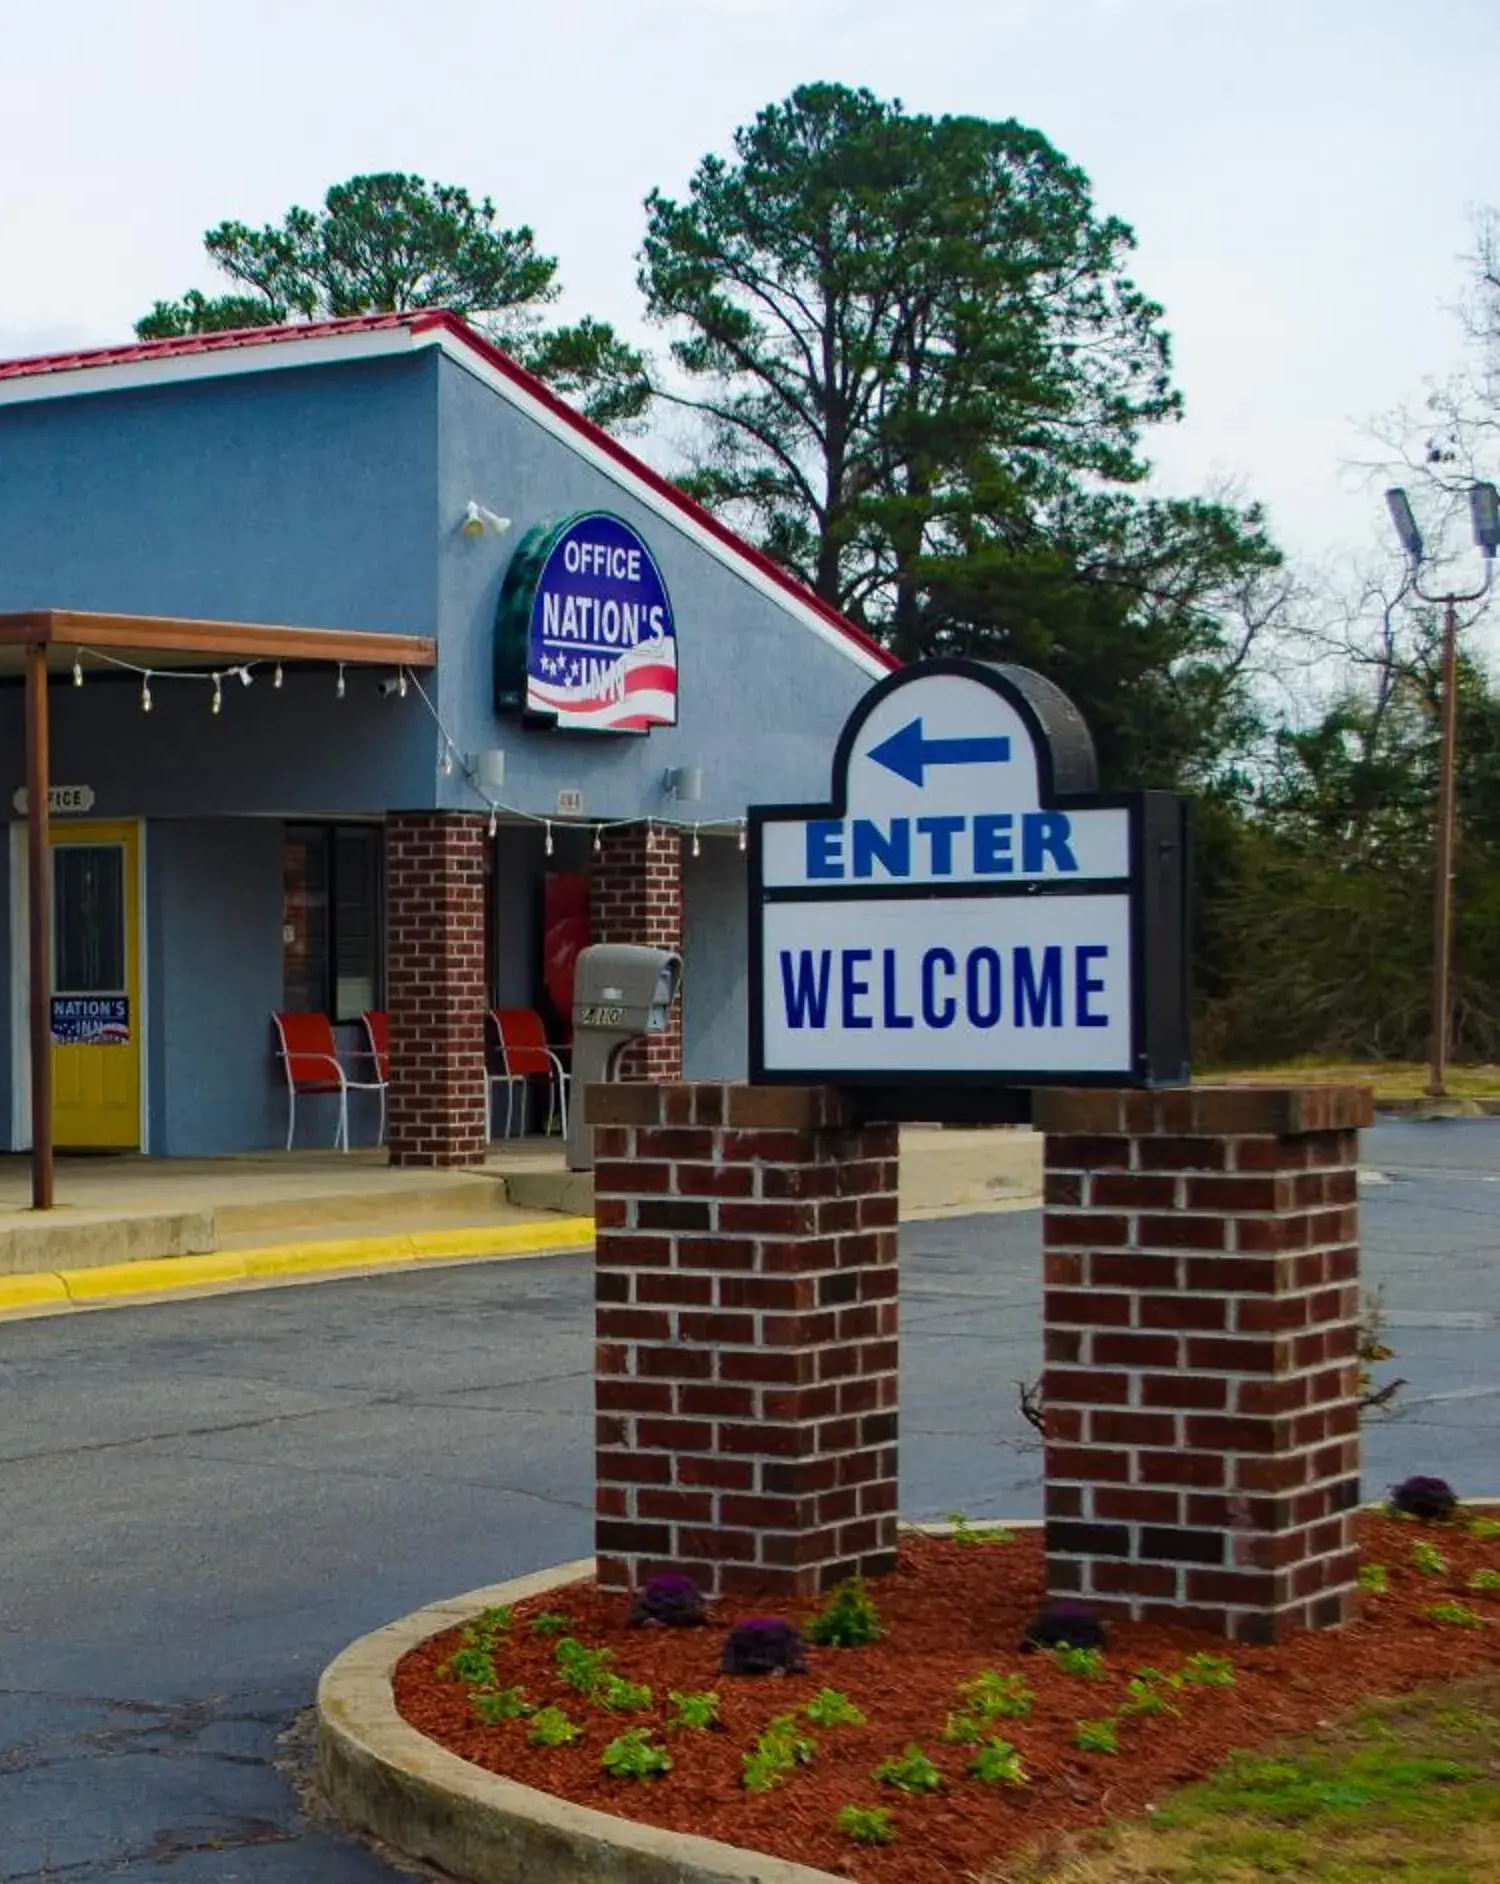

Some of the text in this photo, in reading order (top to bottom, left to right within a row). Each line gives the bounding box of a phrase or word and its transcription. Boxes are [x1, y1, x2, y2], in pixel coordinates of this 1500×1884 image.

[563, 540, 642, 582] OFFICE
[542, 591, 665, 649] NATION'S
[580, 656, 626, 701] INN
[804, 812, 1079, 879] ENTER
[53, 1000, 126, 1017] NATION'S
[779, 945, 1110, 1029] WELCOME
[76, 1019, 104, 1036] INN
